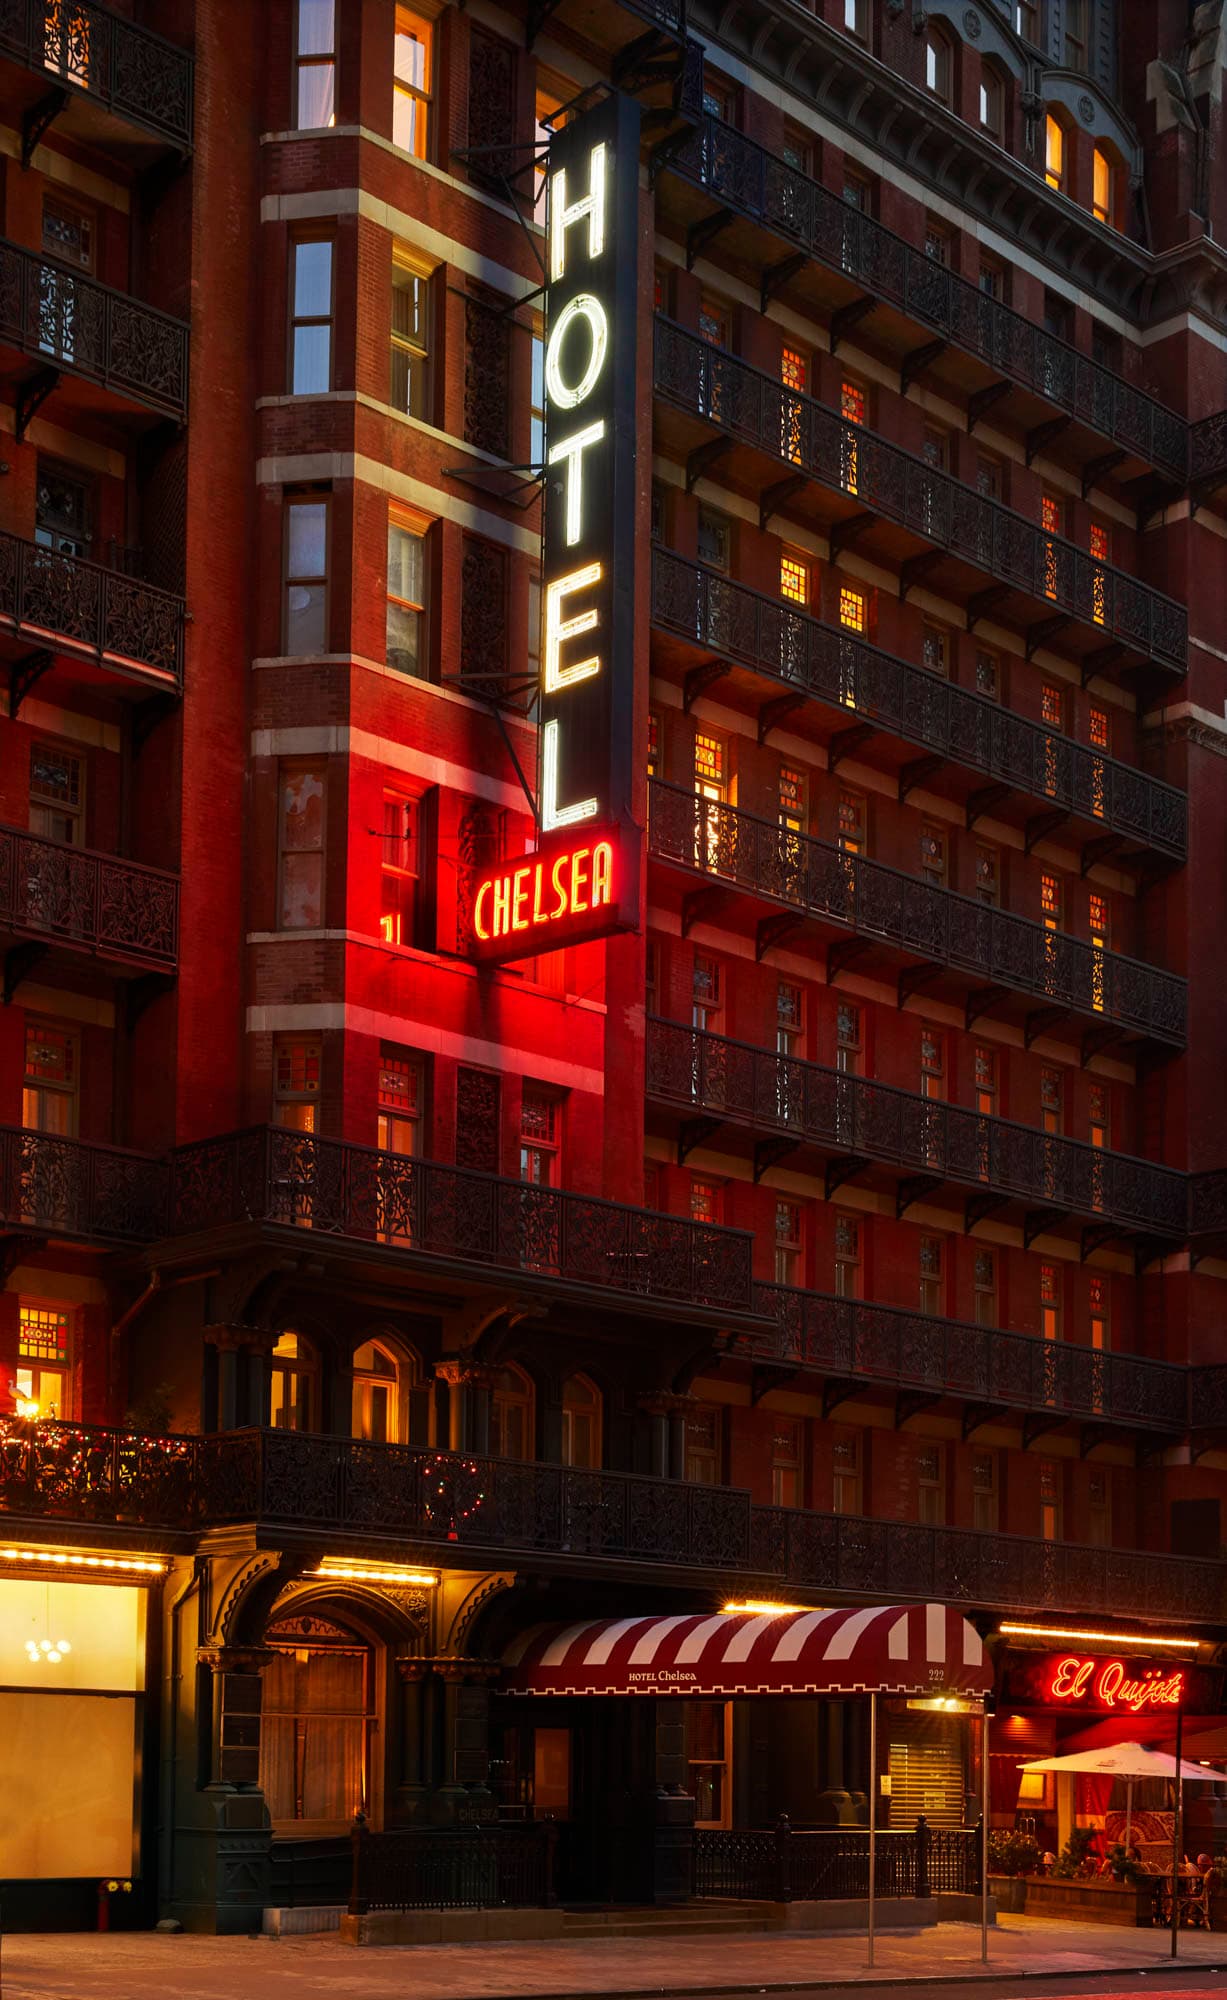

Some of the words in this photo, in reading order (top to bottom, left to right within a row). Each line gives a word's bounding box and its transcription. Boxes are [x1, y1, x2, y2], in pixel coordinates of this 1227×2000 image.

[542, 142, 607, 832] HOTEL
[474, 842, 612, 940] CHELSEA
[629, 1672, 657, 1681] HOTEL
[658, 1670, 697, 1681] Chelsea
[928, 1669, 945, 1681] 222
[1052, 1658, 1095, 1697] El
